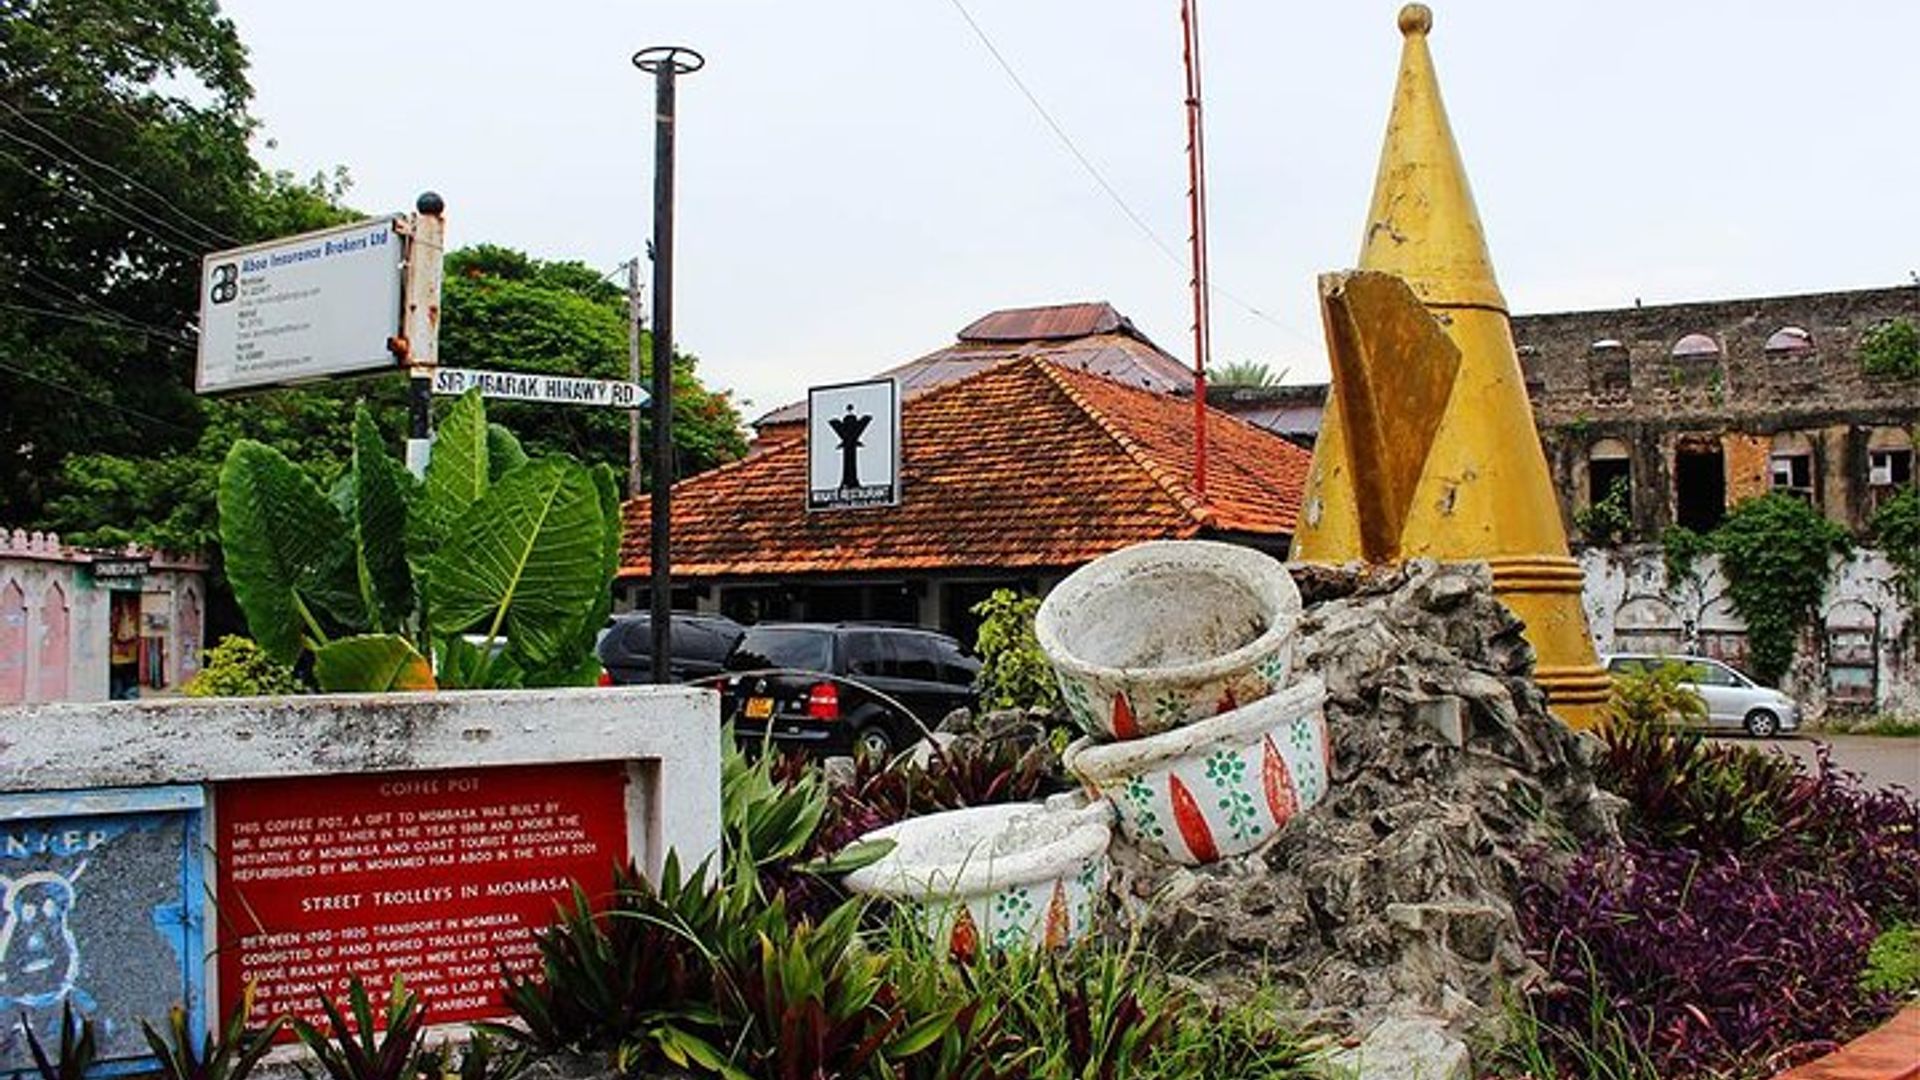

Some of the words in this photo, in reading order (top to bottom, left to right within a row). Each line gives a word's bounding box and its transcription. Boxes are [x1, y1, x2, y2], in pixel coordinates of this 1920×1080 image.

[269, 248, 321, 266] Insurance
[324, 238, 367, 256] Brokers
[370, 228, 388, 246] Ltd
[437, 371, 465, 391] SIR
[546, 379, 606, 399] HINAWY
[612, 383, 634, 402] RD
[380, 780, 439, 796] COFFEE
[448, 778, 480, 792] POT
[232, 822, 260, 834] THIS
[265, 818, 313, 832] COFFEE
[351, 815, 361, 826] A
[365, 813, 392, 825] GIFT
[399, 812, 415, 823] TO
[418, 808, 477, 822] MOMBASA
[481, 806, 506, 817] WAS
[509, 804, 541, 816] BUILT
[544, 802, 560, 813] BY
[258, 835, 310, 848] BURHAN
[313, 833, 334, 844] ALI
[338, 830, 376, 842] TAHER
[379, 828, 393, 839] IN
[397, 826, 420, 838] THE
[424, 824, 457, 836] YEAR
[490, 820, 514, 831] AND
[517, 817, 554, 829] UNDER
[557, 815, 581, 826] THE
[232, 852, 292, 866] INITIATIVE
[297, 849, 312, 861] OF
[319, 845, 380, 859] MOMBASA
[385, 842, 409, 853] AND
[413, 839, 454, 852] COAST
[460, 836, 506, 848] TOURIST
[512, 830, 585, 844] ASSOCIATION
[232, 865, 316, 881] REFURBISHED
[319, 864, 335, 875] BY
[366, 857, 426, 871] MOHAMED
[429, 855, 455, 866] HAJI
[459, 851, 493, 864] ABOO
[497, 850, 509, 861] IN
[513, 847, 535, 859] THE
[540, 845, 567, 857] YEAR
[302, 896, 362, 912] STREET
[373, 888, 452, 906] TROLLEYS
[461, 885, 479, 899] IN
[487, 877, 570, 896] MOMBASA
[241, 933, 300, 949] BETWEEN
[373, 920, 442, 936] TRANSPORT
[445, 918, 458, 929] IN
[461, 914, 519, 928] MOMBASA
[241, 949, 313, 966] CONSISTED
[316, 946, 333, 958] OF
[338, 943, 372, 956] HAND
[376, 938, 423, 952] PUSHED
[428, 933, 487, 947] TROLLEYS
[490, 928, 530, 941] ALONG
[289, 964, 342, 977] RAILWAY
[346, 959, 380, 972] LINES
[384, 956, 422, 968] WHICH
[426, 952, 458, 964] WERE
[461, 948, 489, 960] LAID
[272, 998, 324, 1013] EARLIES
[424, 985, 449, 997] WAS
[452, 981, 480, 994] LAID
[483, 979, 495, 990] IN
[275, 981, 333, 996] REMNANT
[361, 975, 384, 987] THE
[448, 964, 486, 977] TRACK
[490, 963, 502, 974] IS
[432, 996, 488, 1011] HARBOUR
